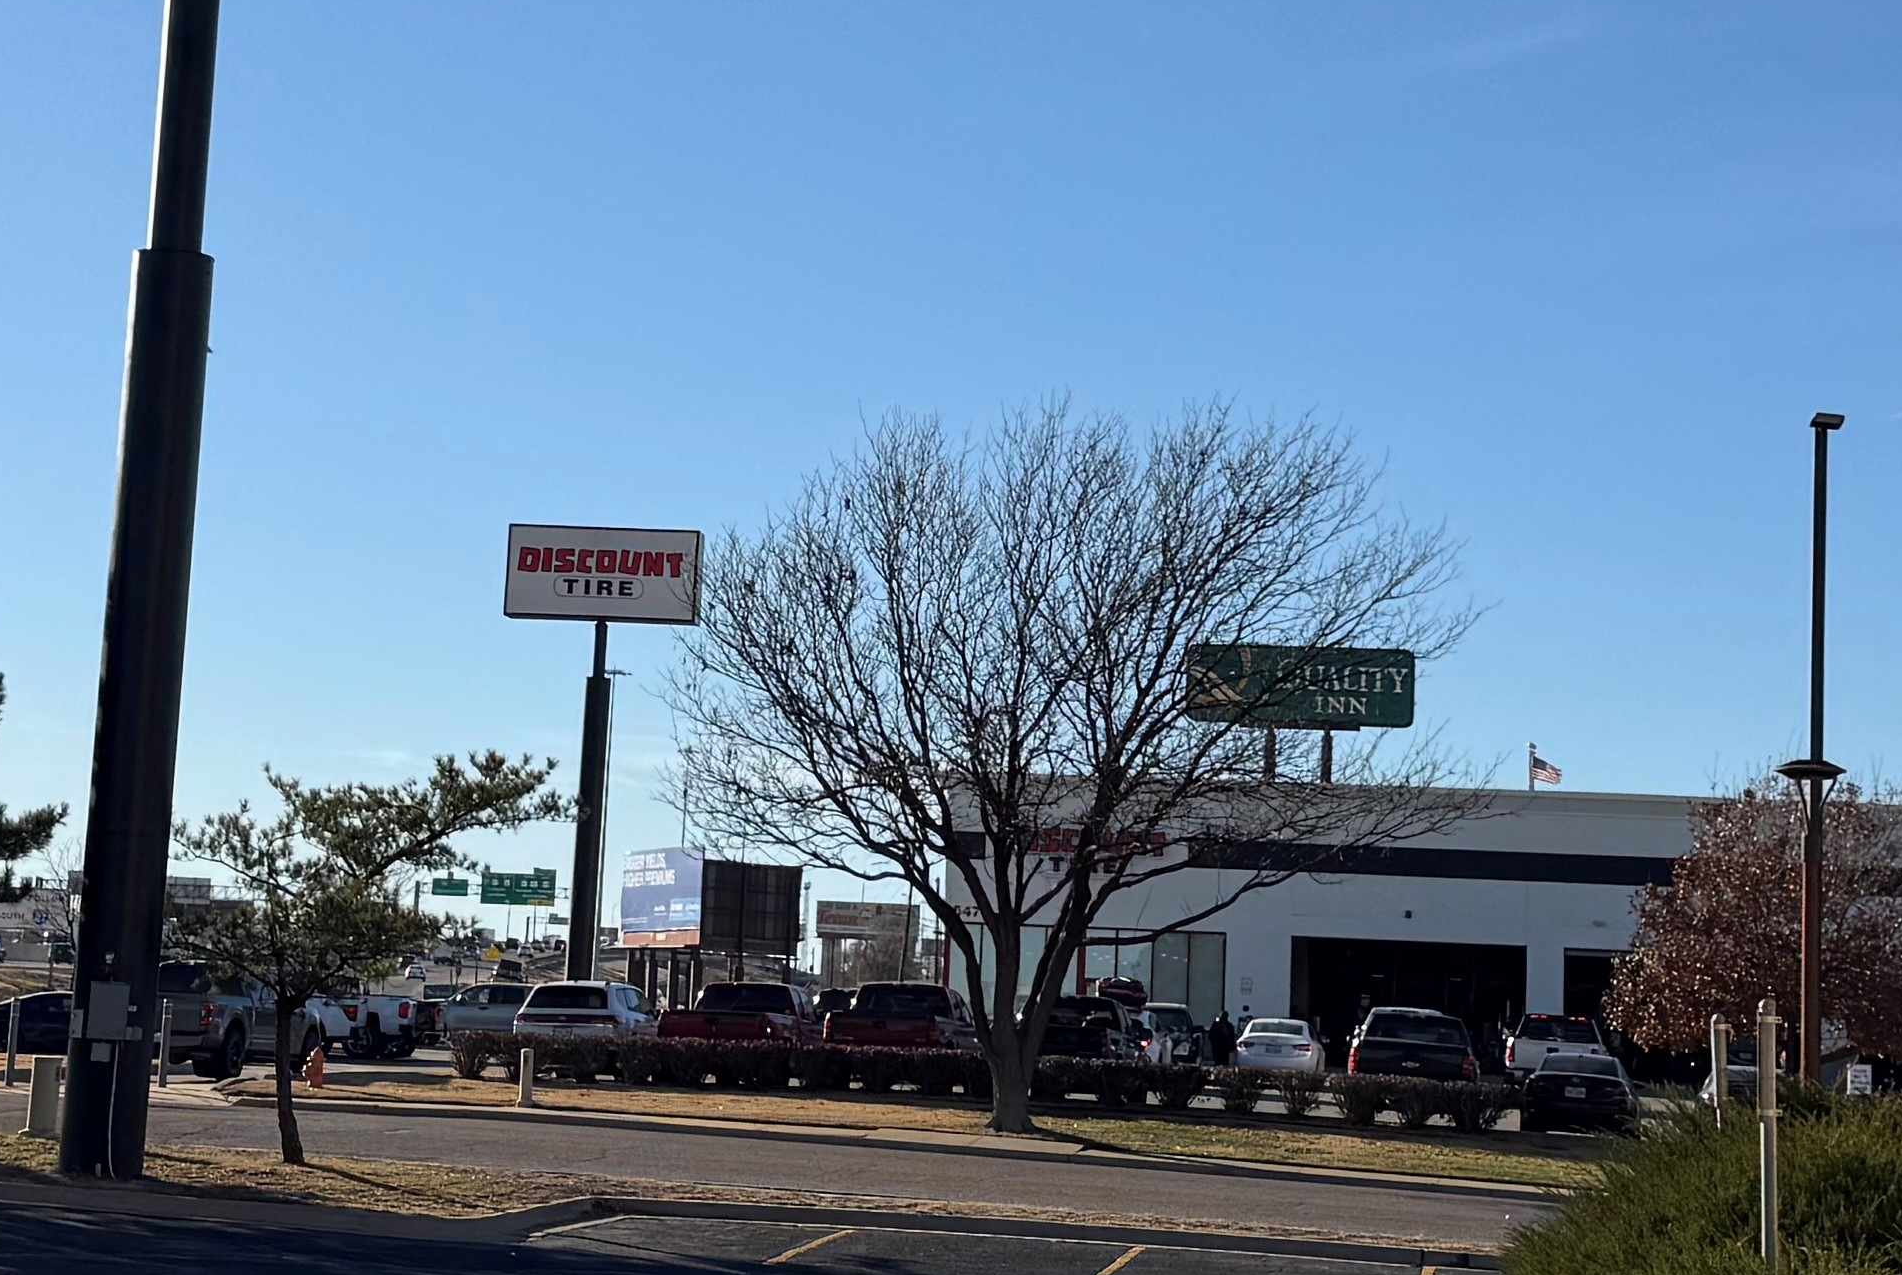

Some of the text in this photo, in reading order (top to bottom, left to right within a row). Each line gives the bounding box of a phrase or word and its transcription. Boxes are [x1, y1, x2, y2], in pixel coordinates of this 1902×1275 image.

[517, 546, 684, 578] DISCOUNT
[562, 578, 634, 597] TIRE
[1276, 659, 1409, 694] QUALITY
[1313, 696, 1368, 715] INN
[1048, 856, 1118, 874] TE
